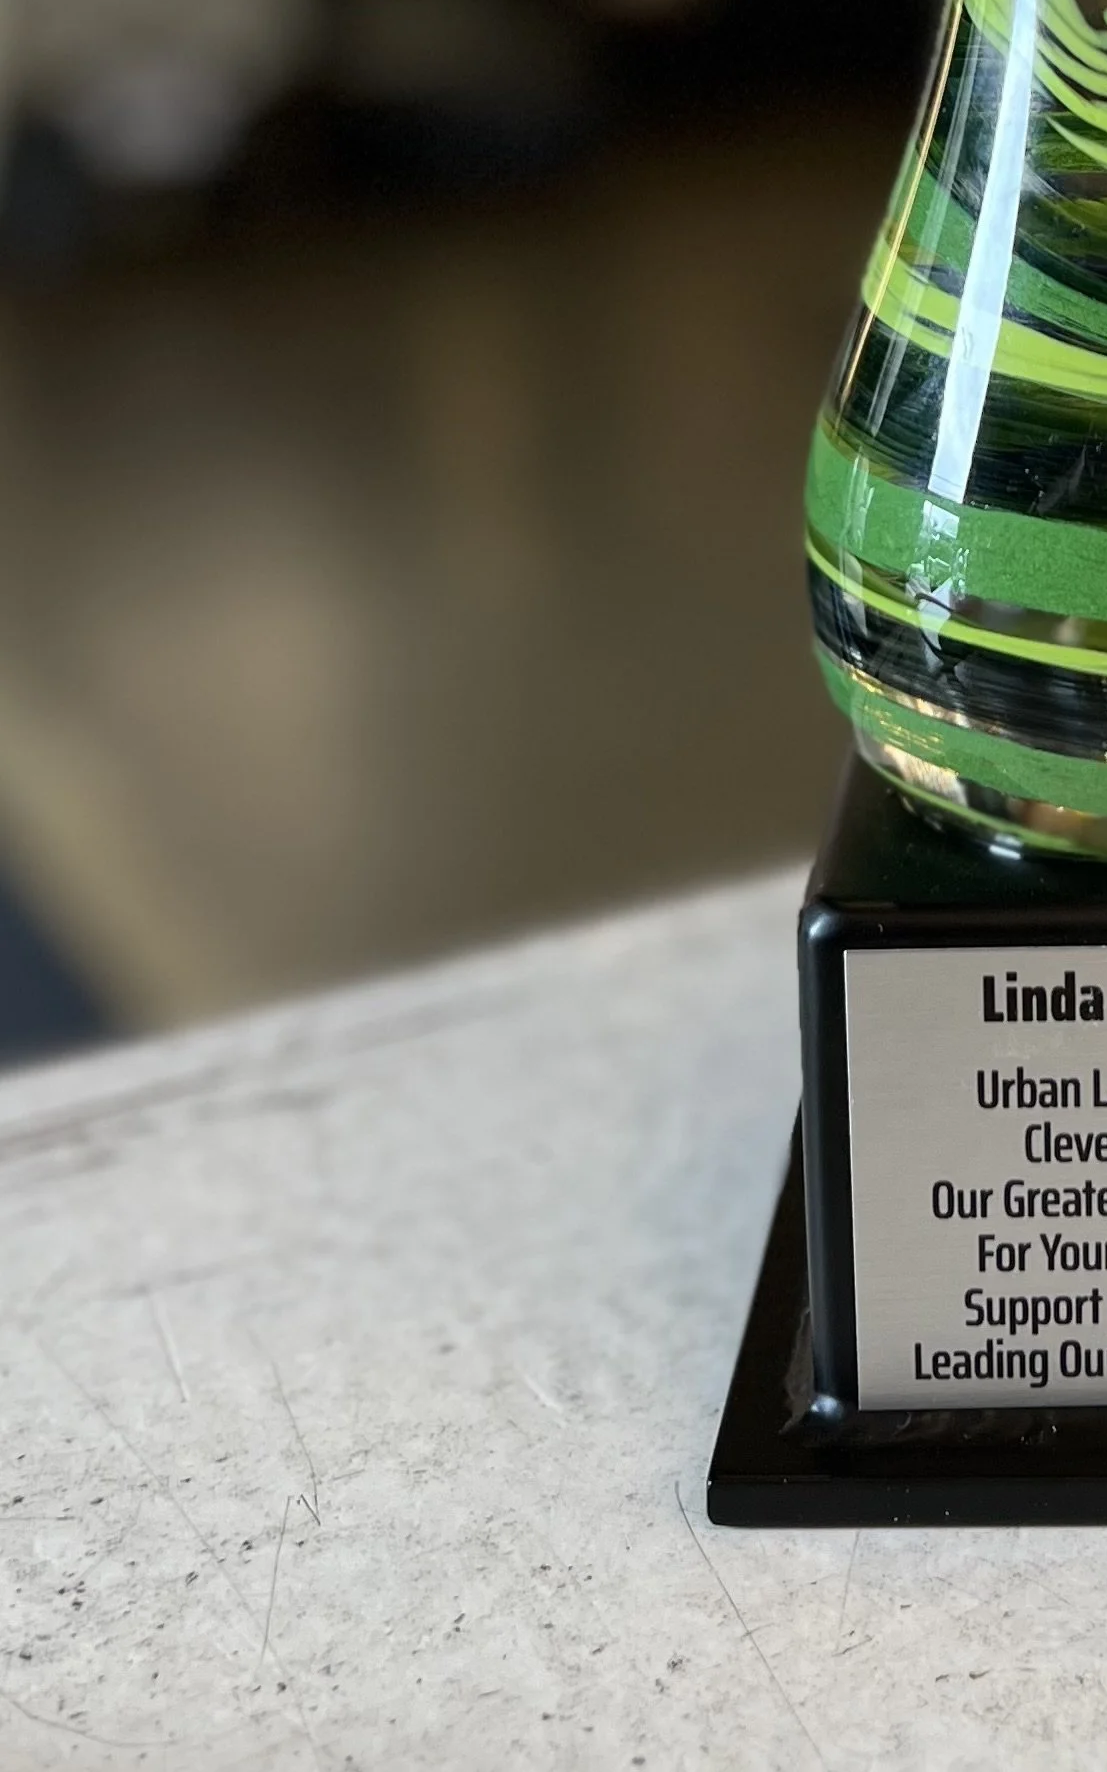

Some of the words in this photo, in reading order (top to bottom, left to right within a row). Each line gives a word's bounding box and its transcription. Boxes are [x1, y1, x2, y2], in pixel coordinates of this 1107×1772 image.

[982, 970, 1105, 1023] Linda
[976, 1067, 1081, 1110] Urban
[931, 1179, 994, 1220] Our
[978, 1233, 1032, 1273] For
[964, 1287, 1104, 1336] Support
[914, 1339, 1049, 1390] Leading
